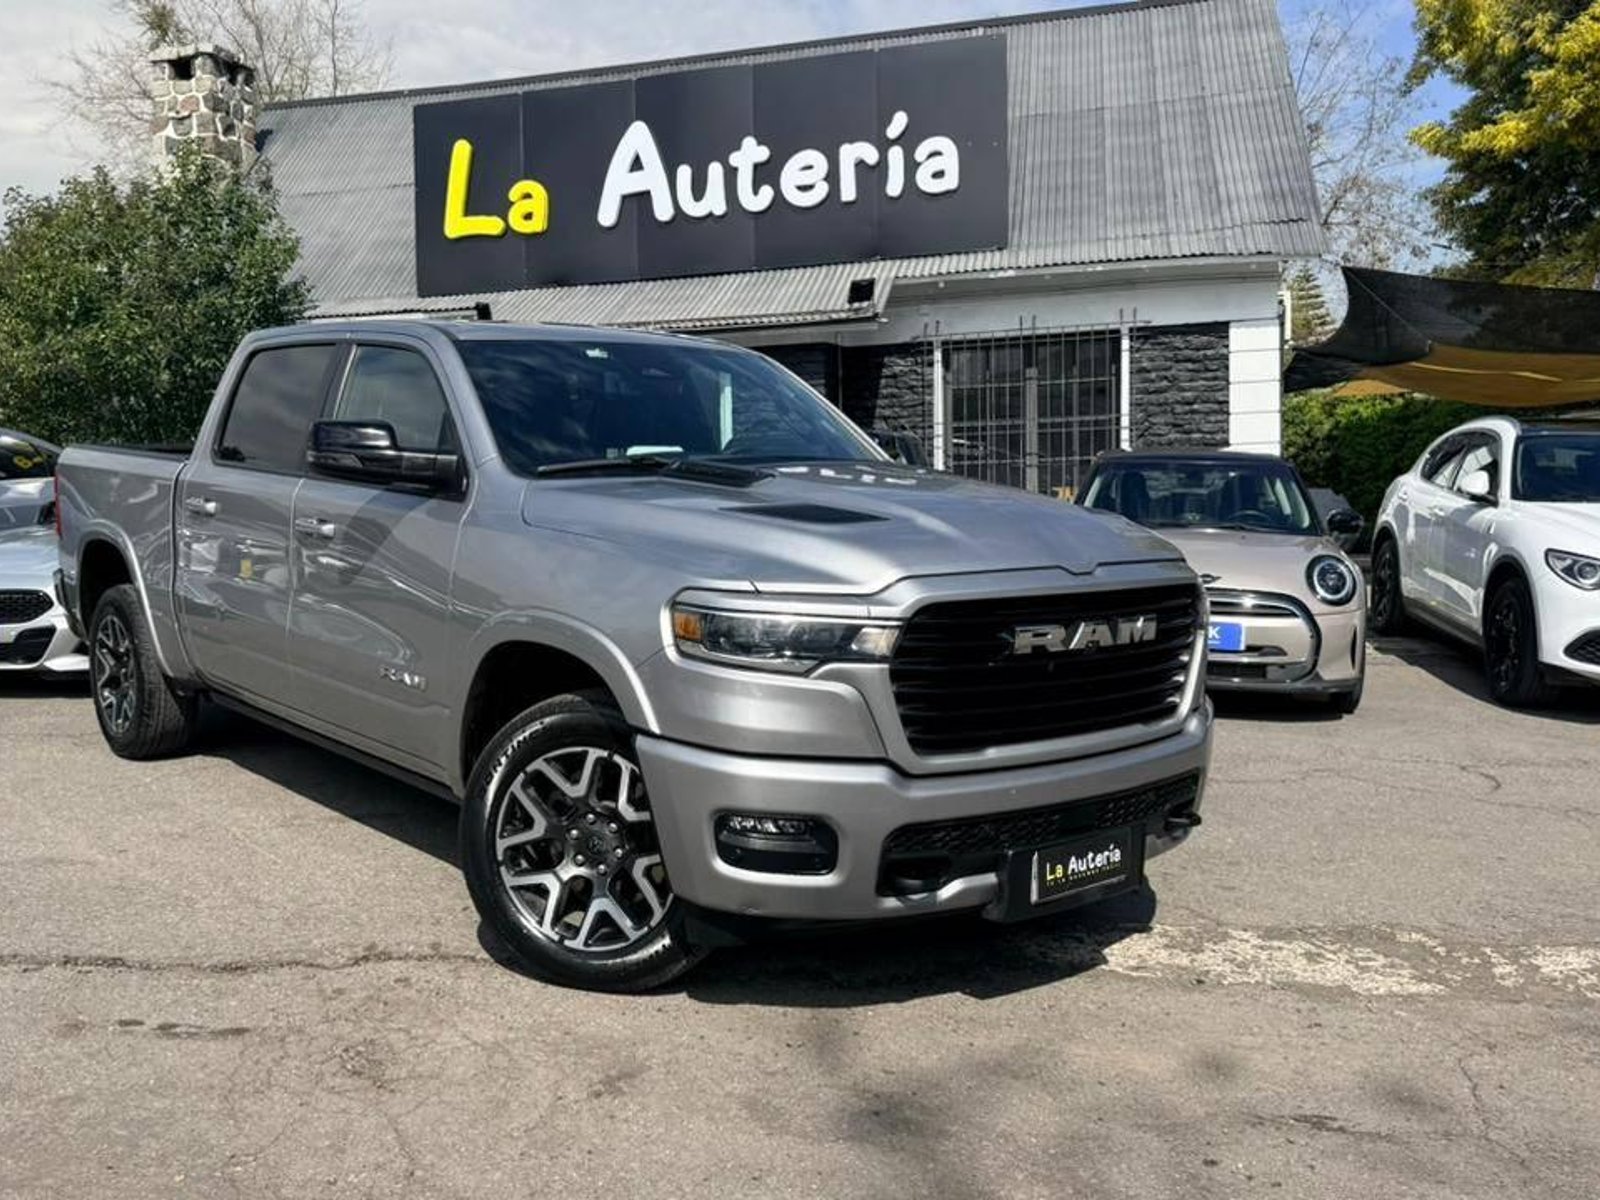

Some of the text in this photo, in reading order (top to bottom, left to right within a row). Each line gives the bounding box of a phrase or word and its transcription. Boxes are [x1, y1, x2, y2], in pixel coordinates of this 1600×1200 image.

[444, 111, 960, 239] La Autería
[1013, 615, 1157, 655] RAM
[1046, 862, 1063, 881] La
[1068, 843, 1121, 875] Autería
